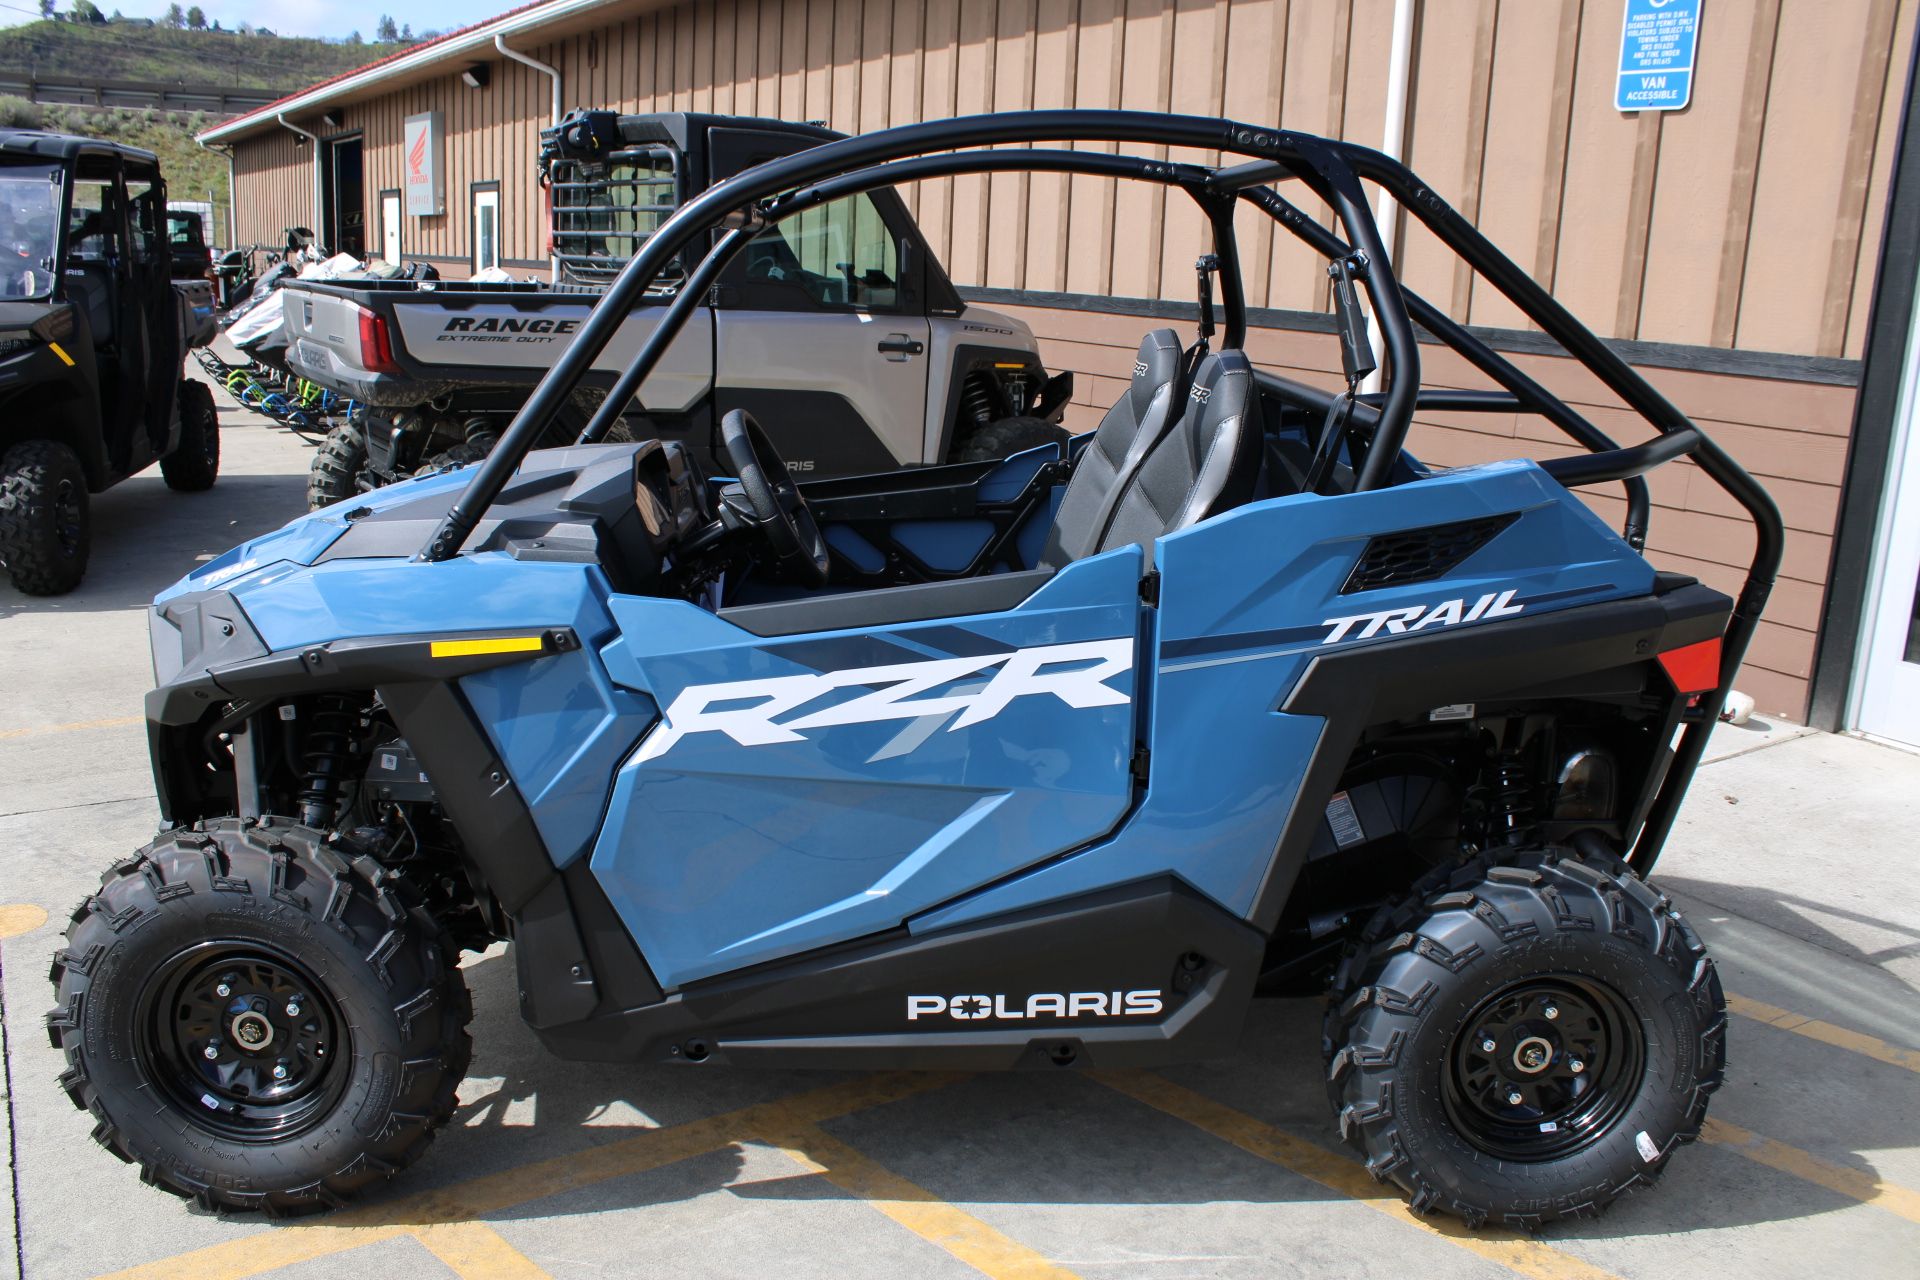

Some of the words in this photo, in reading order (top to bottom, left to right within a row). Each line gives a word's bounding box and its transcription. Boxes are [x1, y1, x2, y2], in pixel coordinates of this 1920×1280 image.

[1638, 35, 1659, 43] TOWING
[1660, 34, 1680, 42] UNDER
[1641, 76, 1666, 88] VAN
[1626, 90, 1677, 100] ACCESSIBLE
[436, 335, 512, 343] EXTREME
[1322, 589, 1525, 645] TRAIL
[628, 637, 1134, 766] RZR
[907, 989, 1163, 1022] POLARIS
